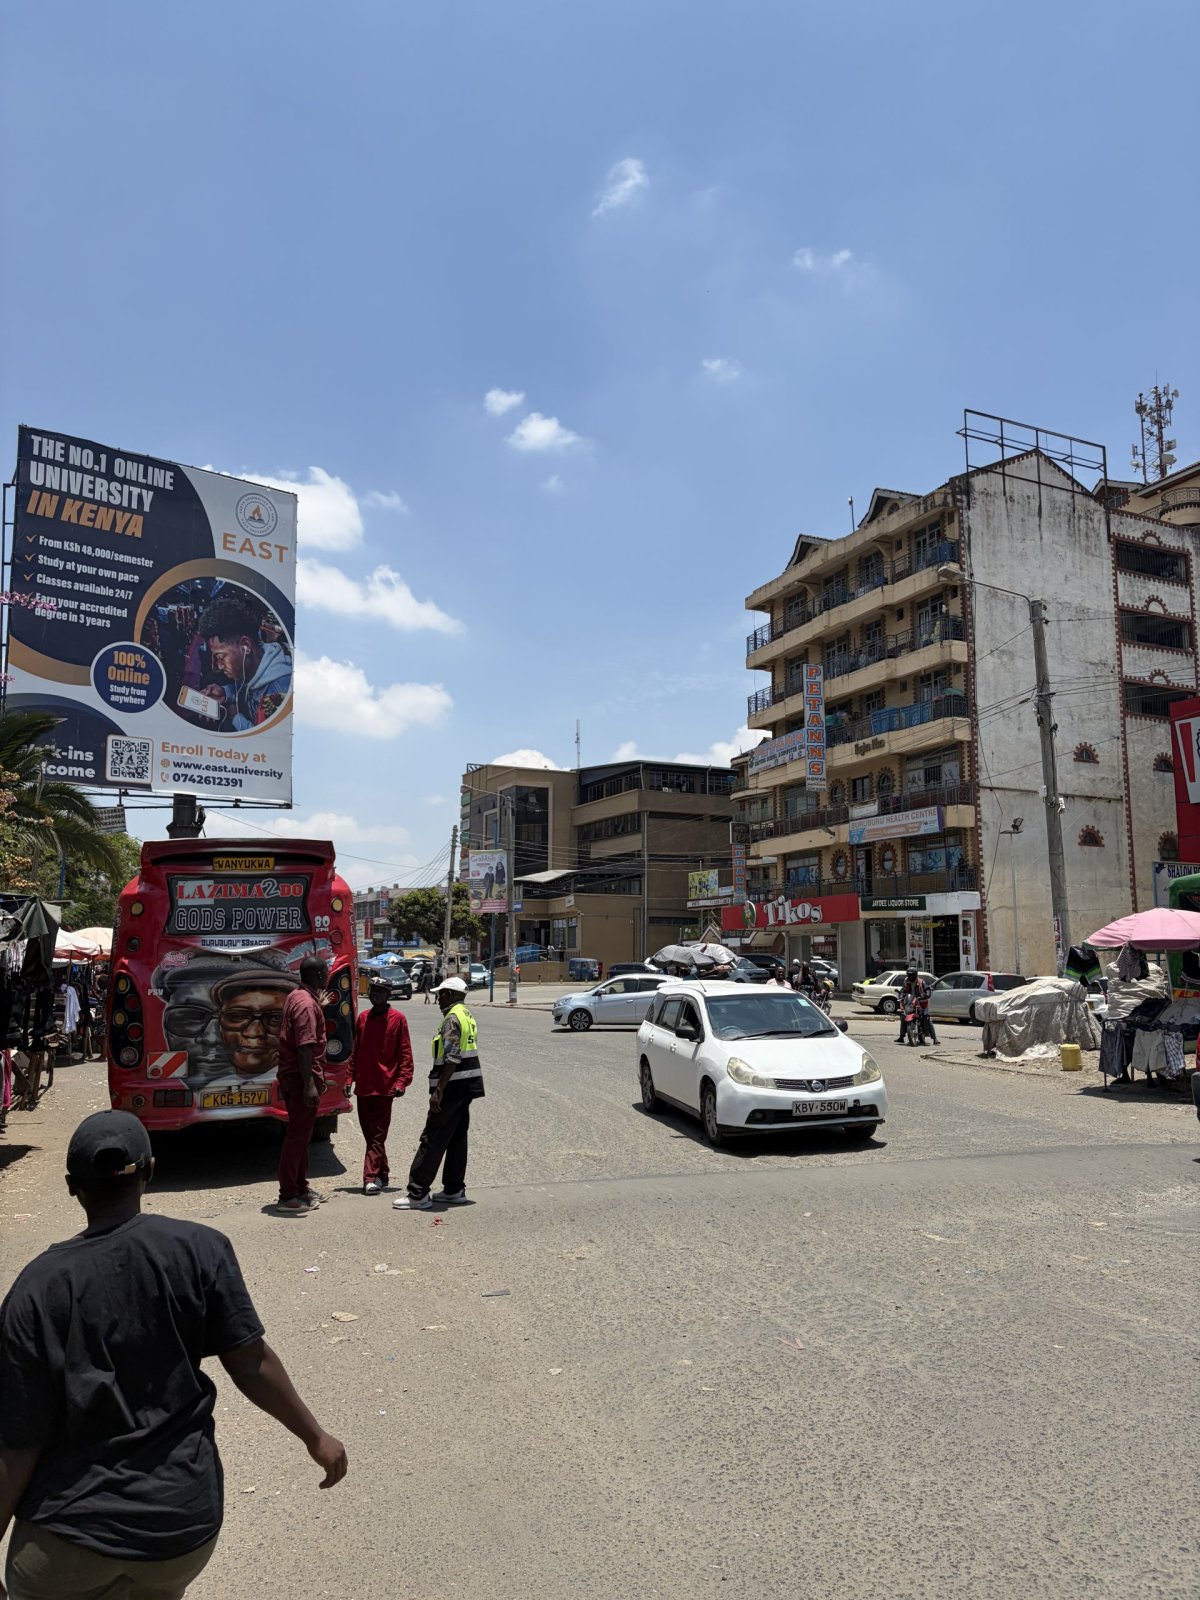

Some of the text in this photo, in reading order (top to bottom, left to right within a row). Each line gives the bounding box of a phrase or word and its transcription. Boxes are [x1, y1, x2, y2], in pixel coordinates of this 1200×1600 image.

[31, 435, 174, 490] THE NO.1 ONLINE
[30, 460, 154, 512] UNIVERSITY
[26, 490, 144, 538] IN KENYA
[39, 535, 154, 568] From KSh 48,000/semester
[223, 532, 289, 563] EAST
[37, 554, 140, 583] Study at your own pace
[36, 573, 133, 600] Classes available 24/7
[35, 592, 128, 618] Earn your accredited
[34, 606, 111, 628] degree in 3 years
[113, 650, 146, 669] 100%
[107, 665, 150, 686] Online
[109, 684, 147, 697] Study from
[110, 694, 146, 706] anywhere
[806, 665, 825, 775] PETANNS
[161, 741, 267, 763] Enroll Today at
[754, 730, 804, 760] PETANN
[172, 760, 283, 780] www.east.university
[172, 772, 243, 788] 0742612391
[885, 813, 910, 823] HEALTH
[910, 809, 937, 820] CENTRE
[217, 859, 271, 869] WANYUKWA
[1168, 864, 1192, 879] SHALOM
[763, 895, 823, 926] Tikos
[887, 899, 905, 908] LIQUOR
[904, 899, 920, 907] STORE
[175, 907, 302, 931] GODS POWER
[315, 916, 330, 927] 80
[201, 939, 237, 948] BURUBURU
[147, 988, 164, 996] PSV
[213, 1092, 263, 1106] KCG 157Y
[794, 1102, 815, 1114] KBV
